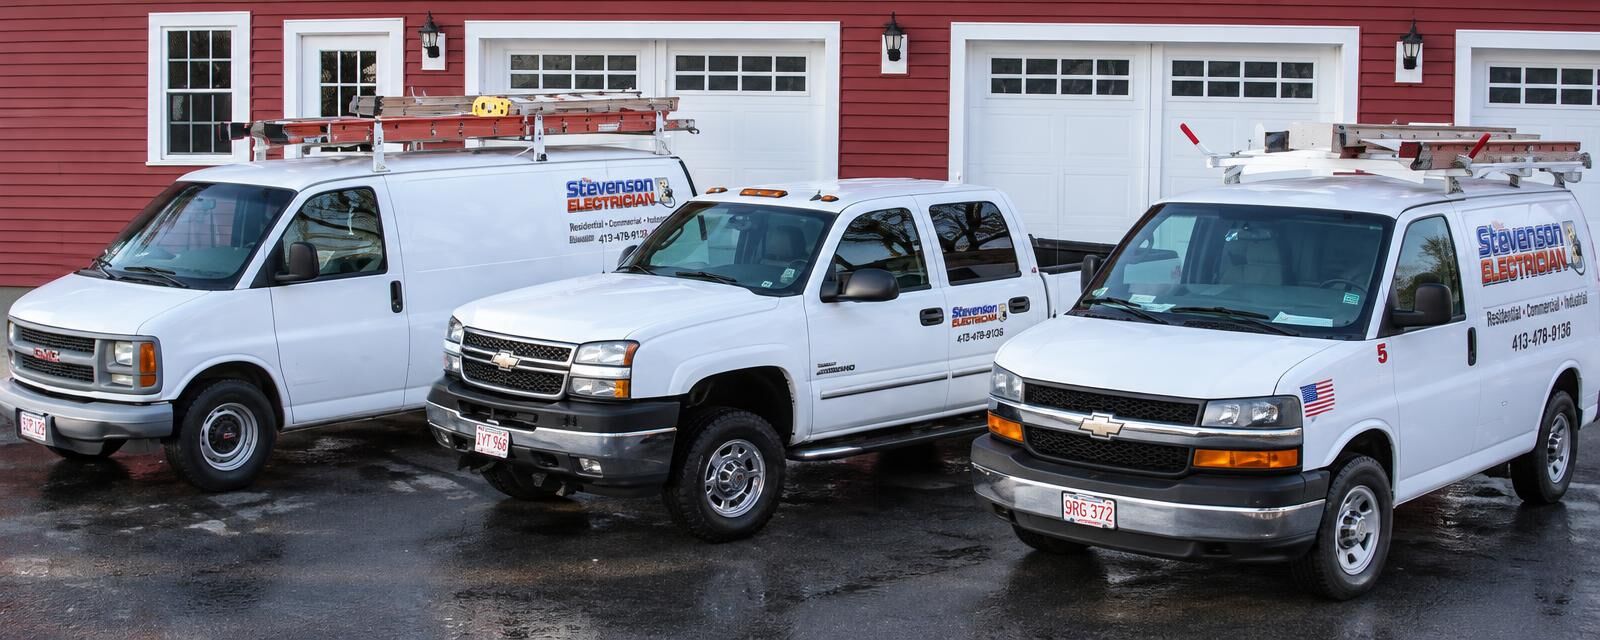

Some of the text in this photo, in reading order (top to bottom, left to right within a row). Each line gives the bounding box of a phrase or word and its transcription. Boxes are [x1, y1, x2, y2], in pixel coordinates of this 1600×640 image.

[566, 178, 655, 198] Stevenson
[567, 192, 656, 213] ELECTRICIAN
[569, 219, 604, 232] Residential
[609, 216, 642, 228] Commercial
[1476, 222, 1564, 259] Stevenson
[1481, 248, 1568, 287] ELECTRICIAN
[952, 304, 998, 318] Stevenson
[1486, 290, 1588, 327] Residential Commercial Industrial
[1512, 321, 1571, 352] 413-478-9136
[33, 347, 60, 363] GMC
[1377, 342, 1388, 364] 5
[1065, 499, 1087, 518] 9RG
[1090, 504, 1113, 522] 372
